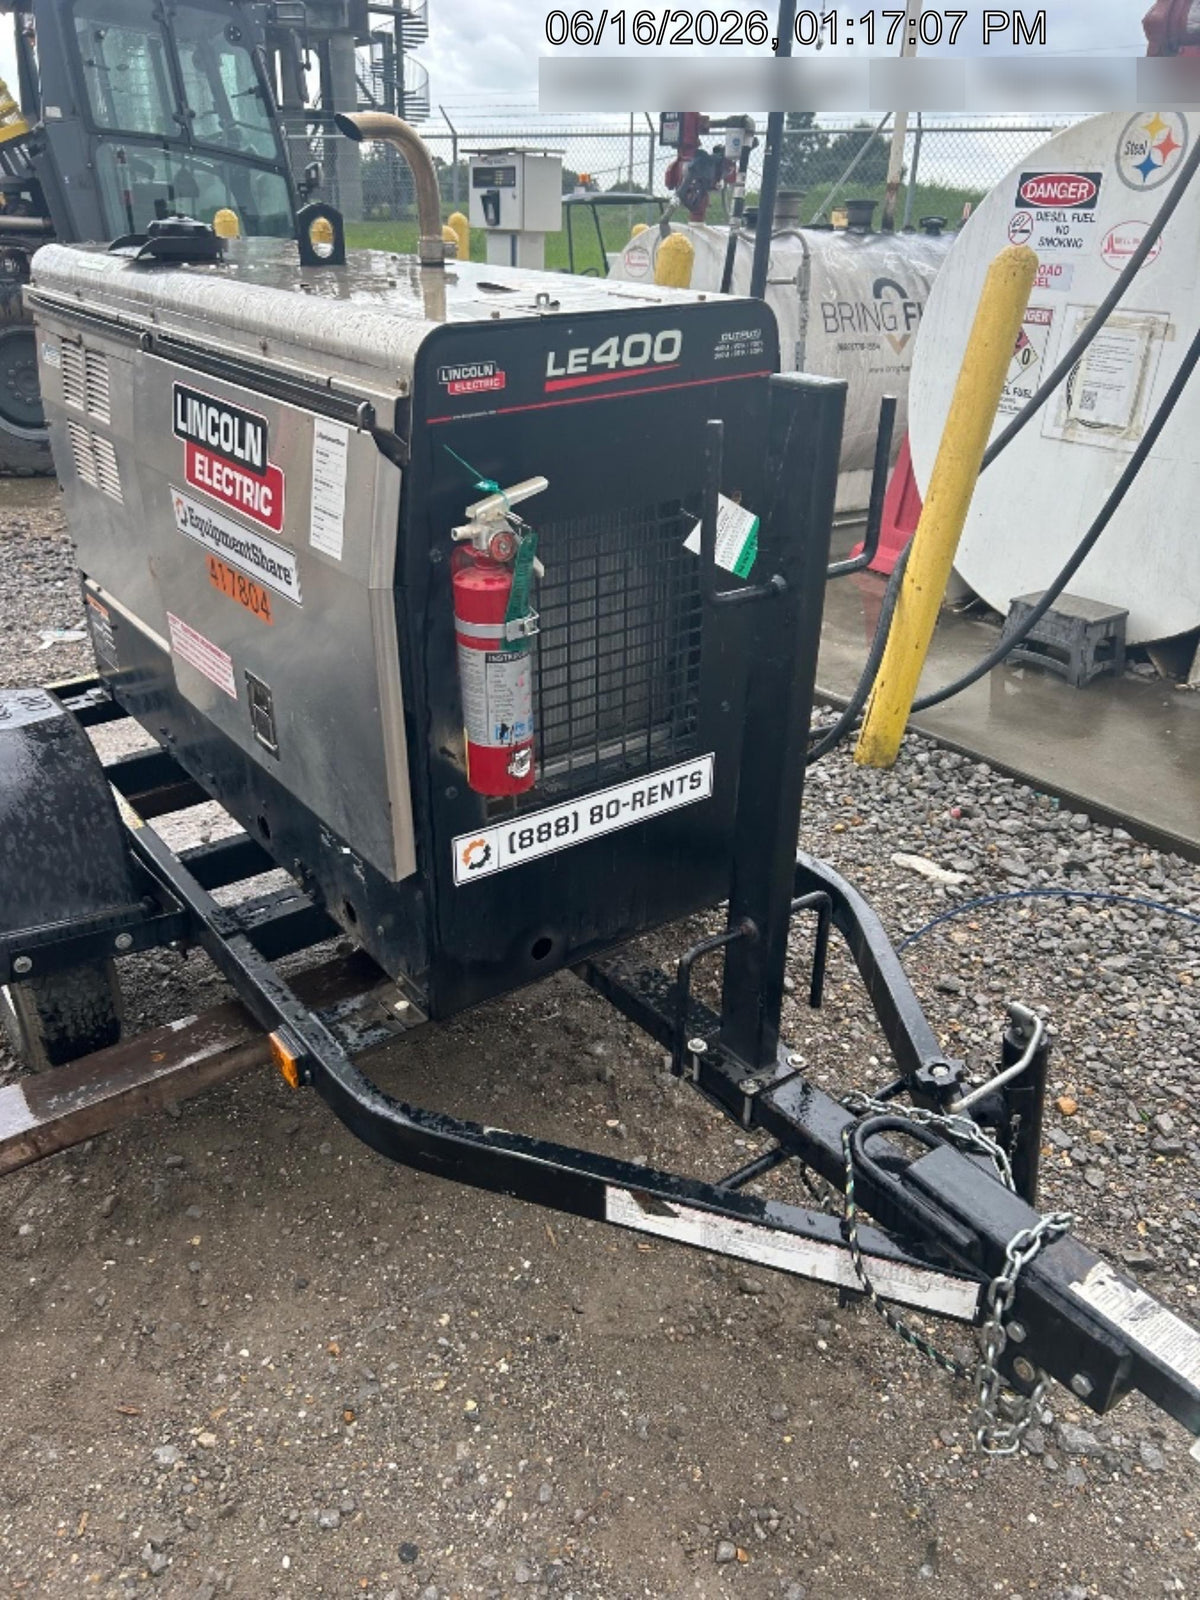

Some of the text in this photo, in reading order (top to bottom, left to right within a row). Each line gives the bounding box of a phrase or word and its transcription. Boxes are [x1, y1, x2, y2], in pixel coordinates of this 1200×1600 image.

[1124, 140, 1147, 156] Steel
[1025, 182, 1089, 199] DANGER
[1036, 211, 1096, 223] DIESEL FUEL
[1056, 226, 1070, 235] NO
[1038, 236, 1084, 249] SMOKING
[1038, 264, 1063, 277] OAD
[820, 301, 898, 333] BRING
[546, 329, 683, 377] LE400
[441, 364, 494, 382] LINCOLN
[454, 379, 500, 392] ELECTRIC
[176, 393, 262, 467] LINCOLN
[194, 452, 273, 517] ELECTRIC
[187, 504, 293, 587] EquipmentShare
[508, 770, 703, 855] (888) 80-RENTS
